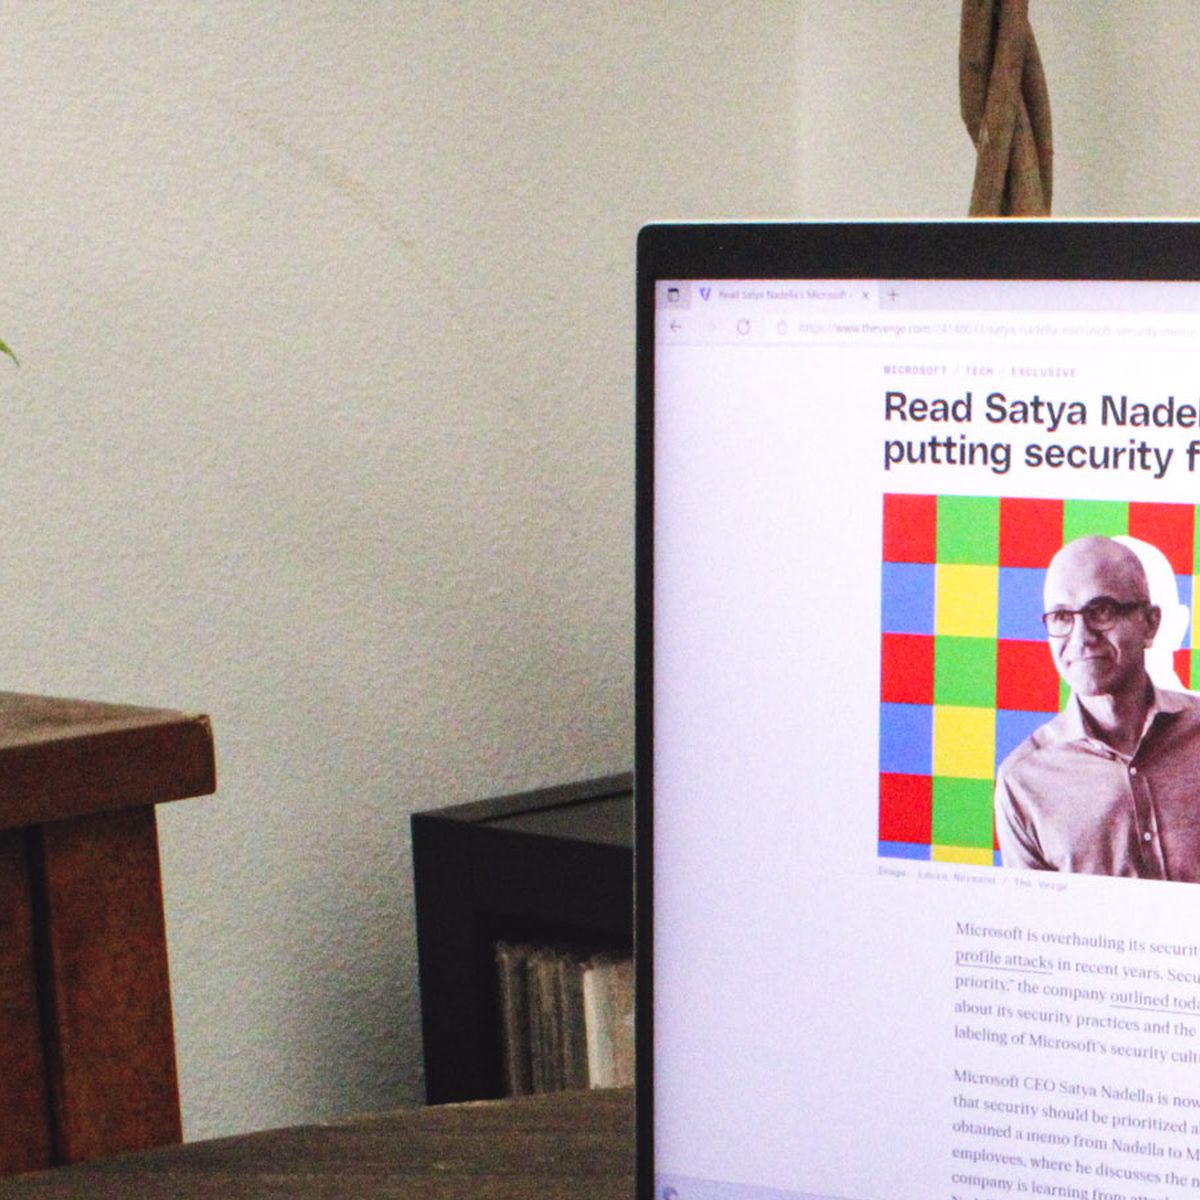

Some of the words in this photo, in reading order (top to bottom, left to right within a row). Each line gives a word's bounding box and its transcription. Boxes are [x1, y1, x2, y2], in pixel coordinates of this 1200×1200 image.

[885, 391, 972, 423] Read
[985, 391, 1087, 433] Satya
[884, 434, 1011, 475] putting
[1024, 438, 1174, 480] security
[956, 921, 1022, 941] Microsoft
[1026, 928, 1038, 942] is
[1040, 931, 1125, 953] overhauling
[1128, 938, 1145, 952] its
[955, 949, 1001, 964] profile
[1004, 954, 1054, 969] attacks
[1057, 958, 1071, 971] in
[1075, 962, 1118, 976] recent
[1122, 966, 1164, 980] years.
[1017, 978, 1040, 994] the
[1042, 985, 1105, 1001] company
[1110, 990, 1169, 1008] outlined
[954, 999, 992, 1016] about
[996, 1005, 1014, 1018] its
[1016, 1009, 1072, 1024] security
[1076, 1015, 1140, 1031] practices
[1143, 1020, 1170, 1034] and
[1173, 1021, 1196, 1037] the
[954, 1024, 1008, 1046] labeling
[1010, 1031, 1026, 1045] of
[1110, 1045, 1166, 1062] security
[954, 1068, 1019, 1088] Microsoft
[1023, 1076, 1056, 1092] CEO
[1059, 1081, 1097, 1098] Satya
[1100, 1084, 1154, 1104] Nadella
[1157, 1091, 1168, 1105] is
[952, 1093, 979, 1110] that
[983, 1100, 1038, 1117] security
[1041, 1104, 1088, 1122] should
[1091, 1109, 1108, 1124] be
[1112, 1114, 1187, 1133] prioritized
[951, 1119, 1012, 1138] obtained
[1014, 1130, 1023, 1140] a
[1026, 1131, 1070, 1146] memo
[1073, 1134, 1108, 1150] from
[1111, 1138, 1164, 1157] Nadella
[1167, 1146, 1183, 1159] to
[951, 1148, 1026, 1168] employees,
[1029, 1155, 1072, 1172] where
[1075, 1159, 1092, 1174] he
[1094, 1162, 1161, 1183] discusses
[1164, 1171, 1187, 1187] the
[951, 1173, 1013, 1192] company
[1017, 1178, 1028, 1192] is
